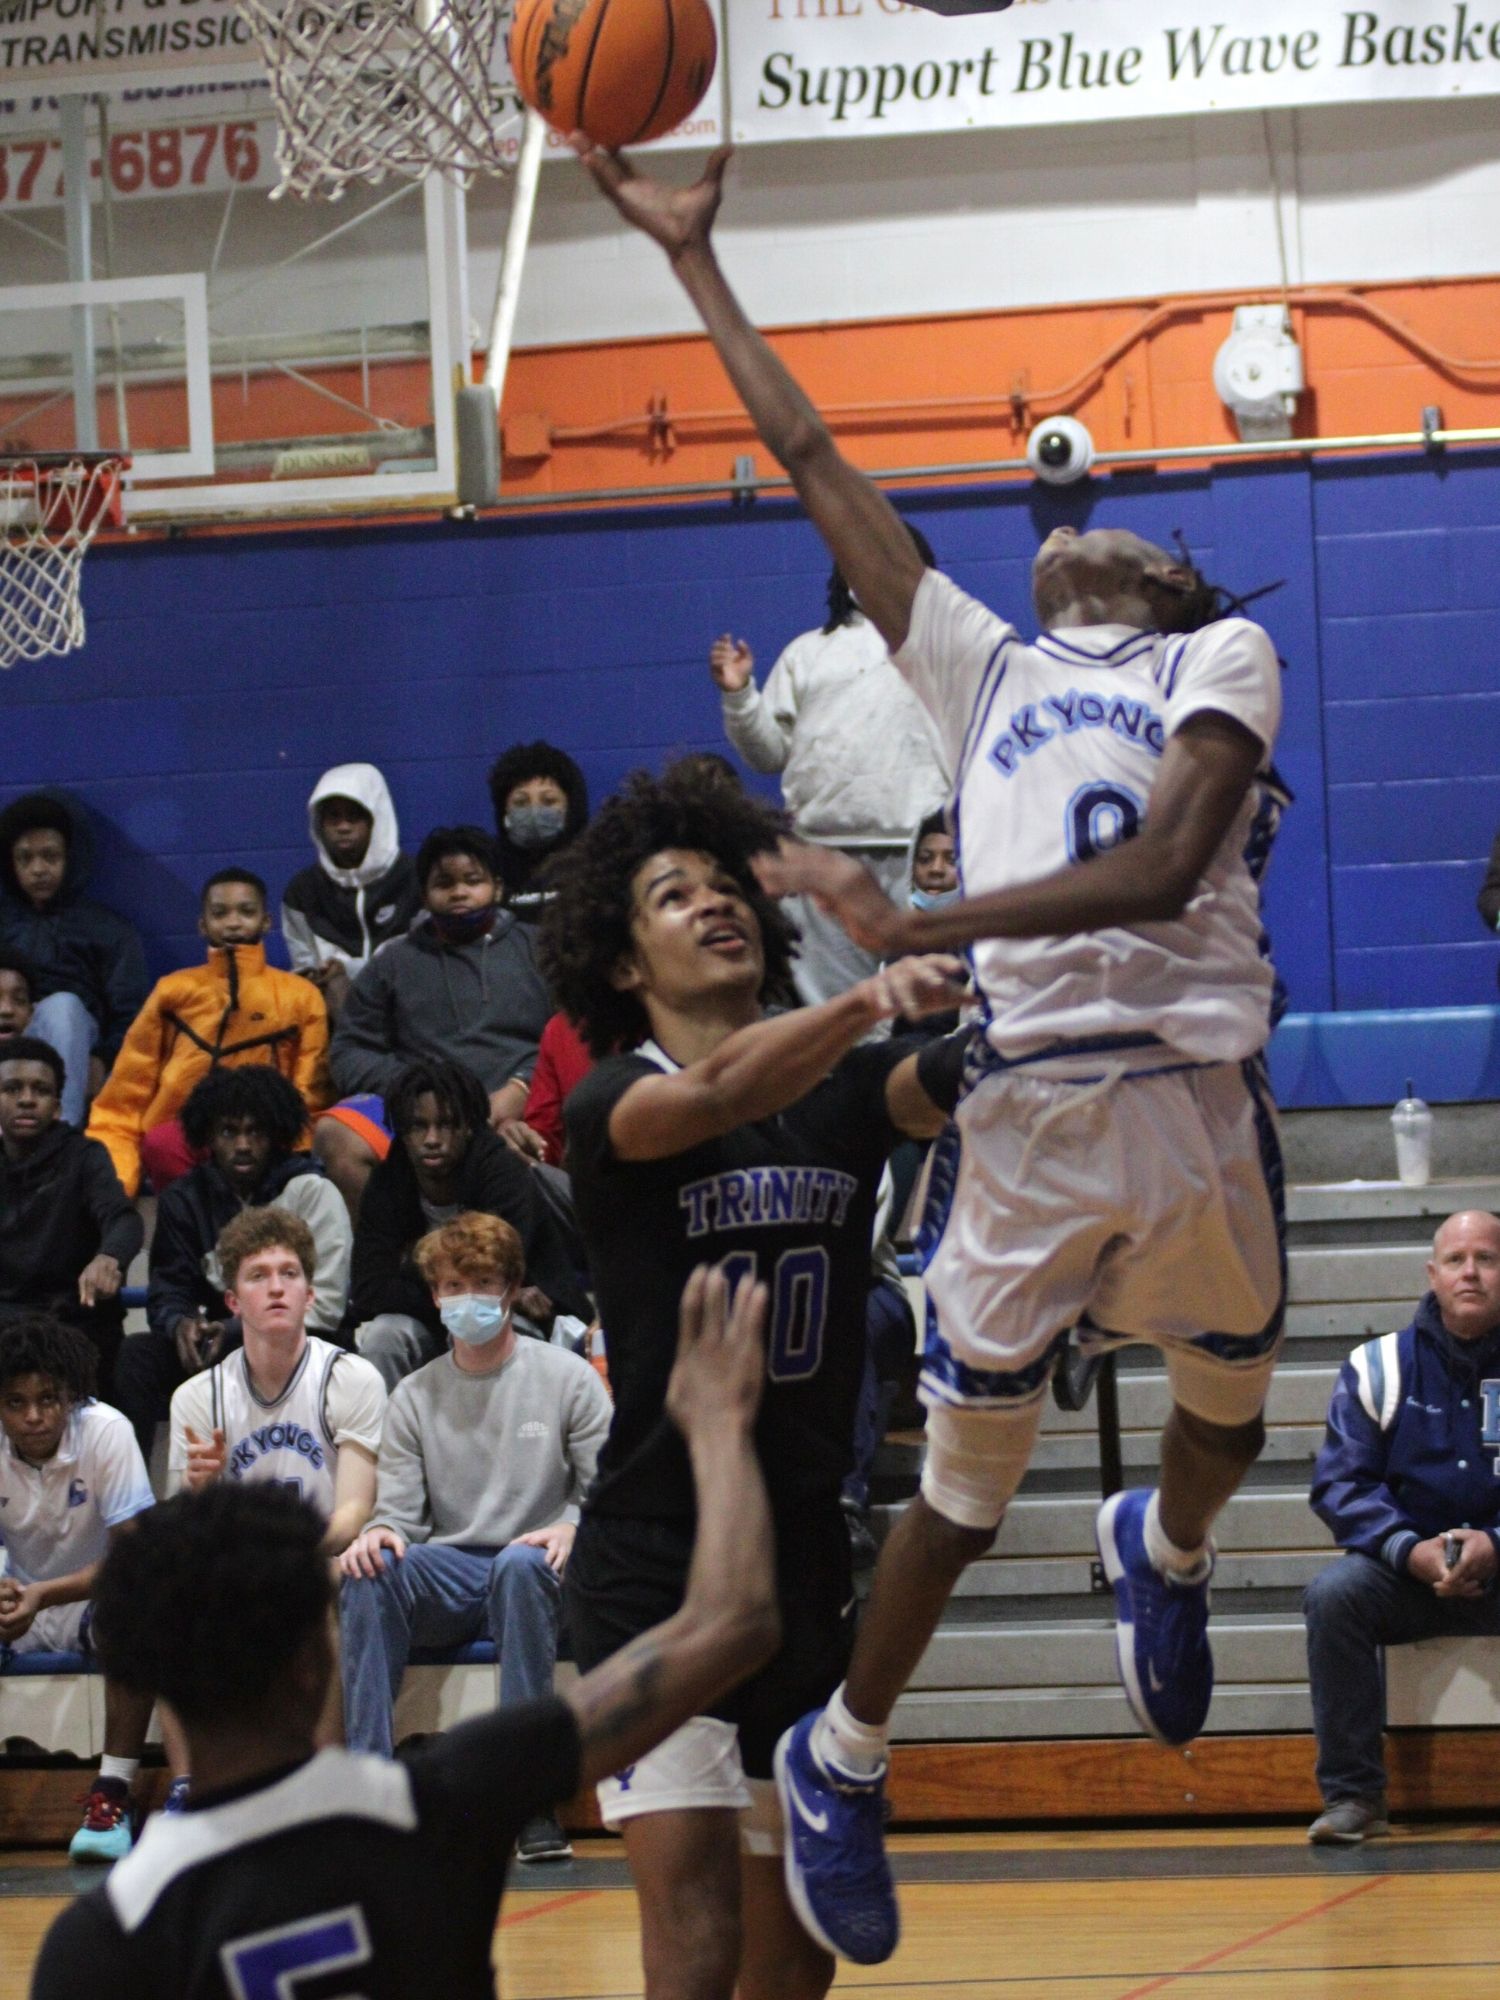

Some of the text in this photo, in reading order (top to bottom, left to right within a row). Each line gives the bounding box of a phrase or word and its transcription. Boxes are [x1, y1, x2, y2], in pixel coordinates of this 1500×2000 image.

[758, 47, 998, 120] Support
[1013, 32, 1142, 93] Blue
[1163, 24, 1320, 80] Wave
[679, 1166, 858, 1237] TRINITY
